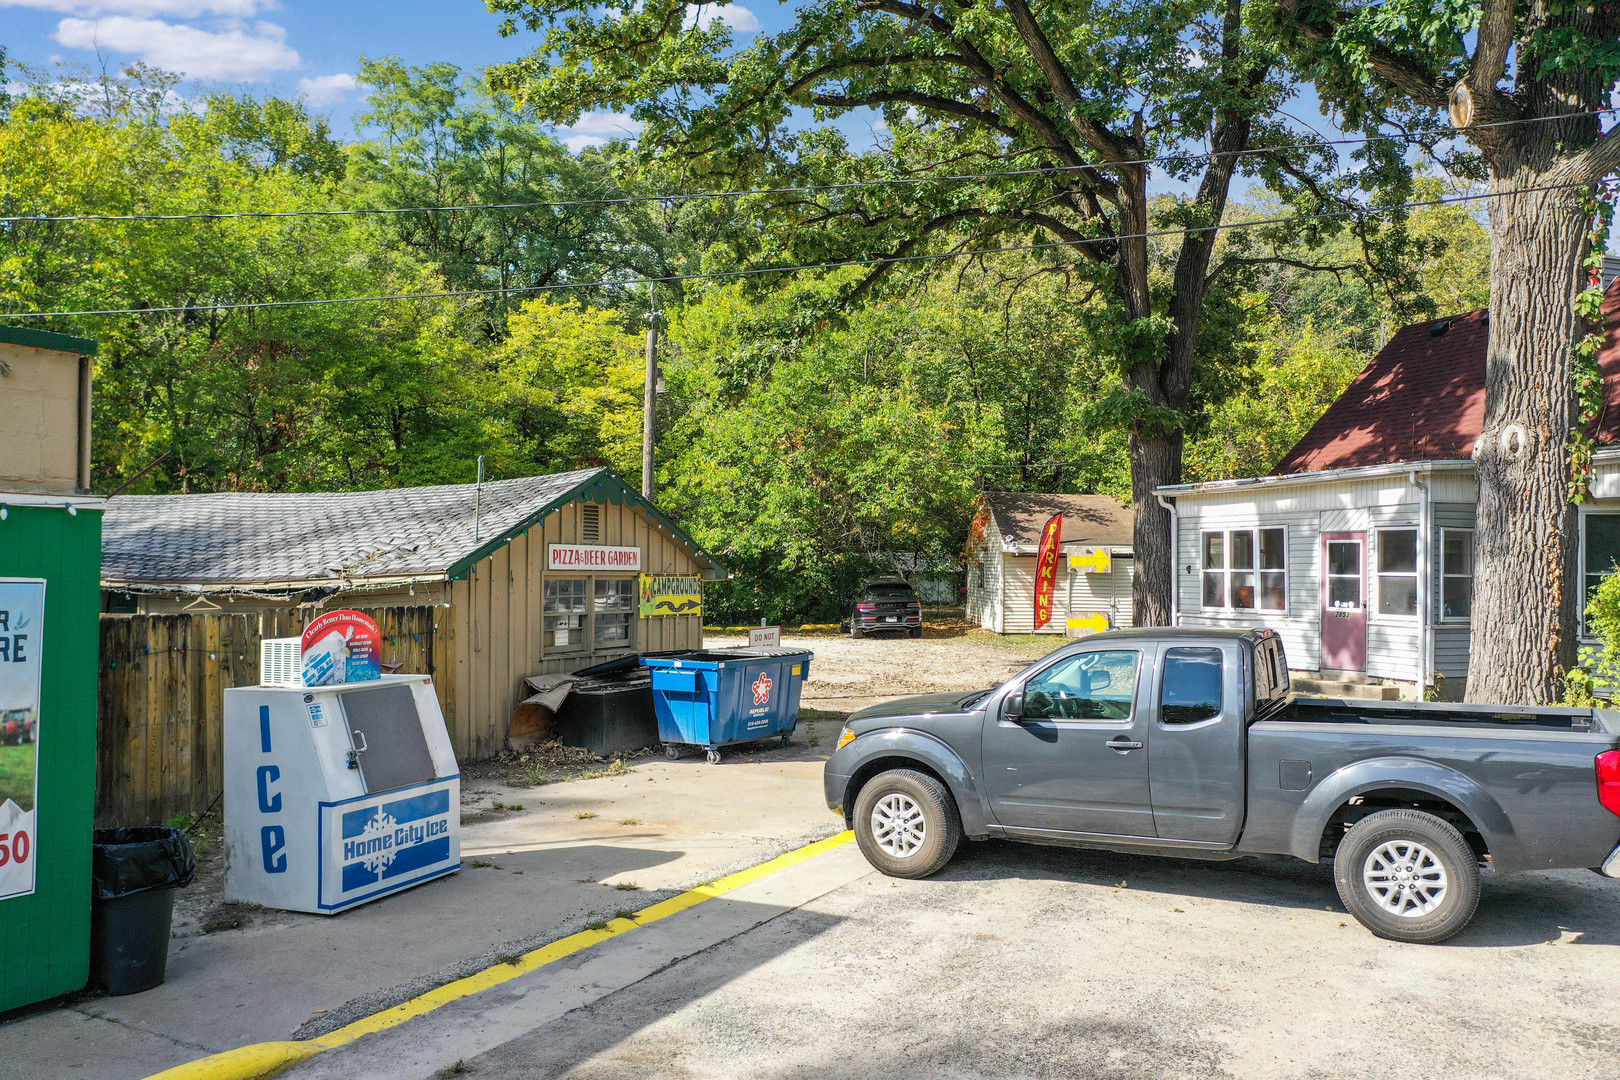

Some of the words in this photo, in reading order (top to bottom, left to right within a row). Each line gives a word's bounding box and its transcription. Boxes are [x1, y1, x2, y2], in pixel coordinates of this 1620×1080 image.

[607, 550, 638, 567] GARDEN
[1038, 523, 1058, 621] PARKING
[651, 576, 703, 596] CAMPGROUNDS
[305, 622, 323, 639] Clearly
[322, 615, 339, 626] Better
[338, 613, 352, 621] Than
[754, 633, 763, 642] DO
[763, 632, 775, 641] NOT
[343, 833, 393, 861] Home
[394, 825, 425, 847] City
[425, 818, 448, 838] Ice
